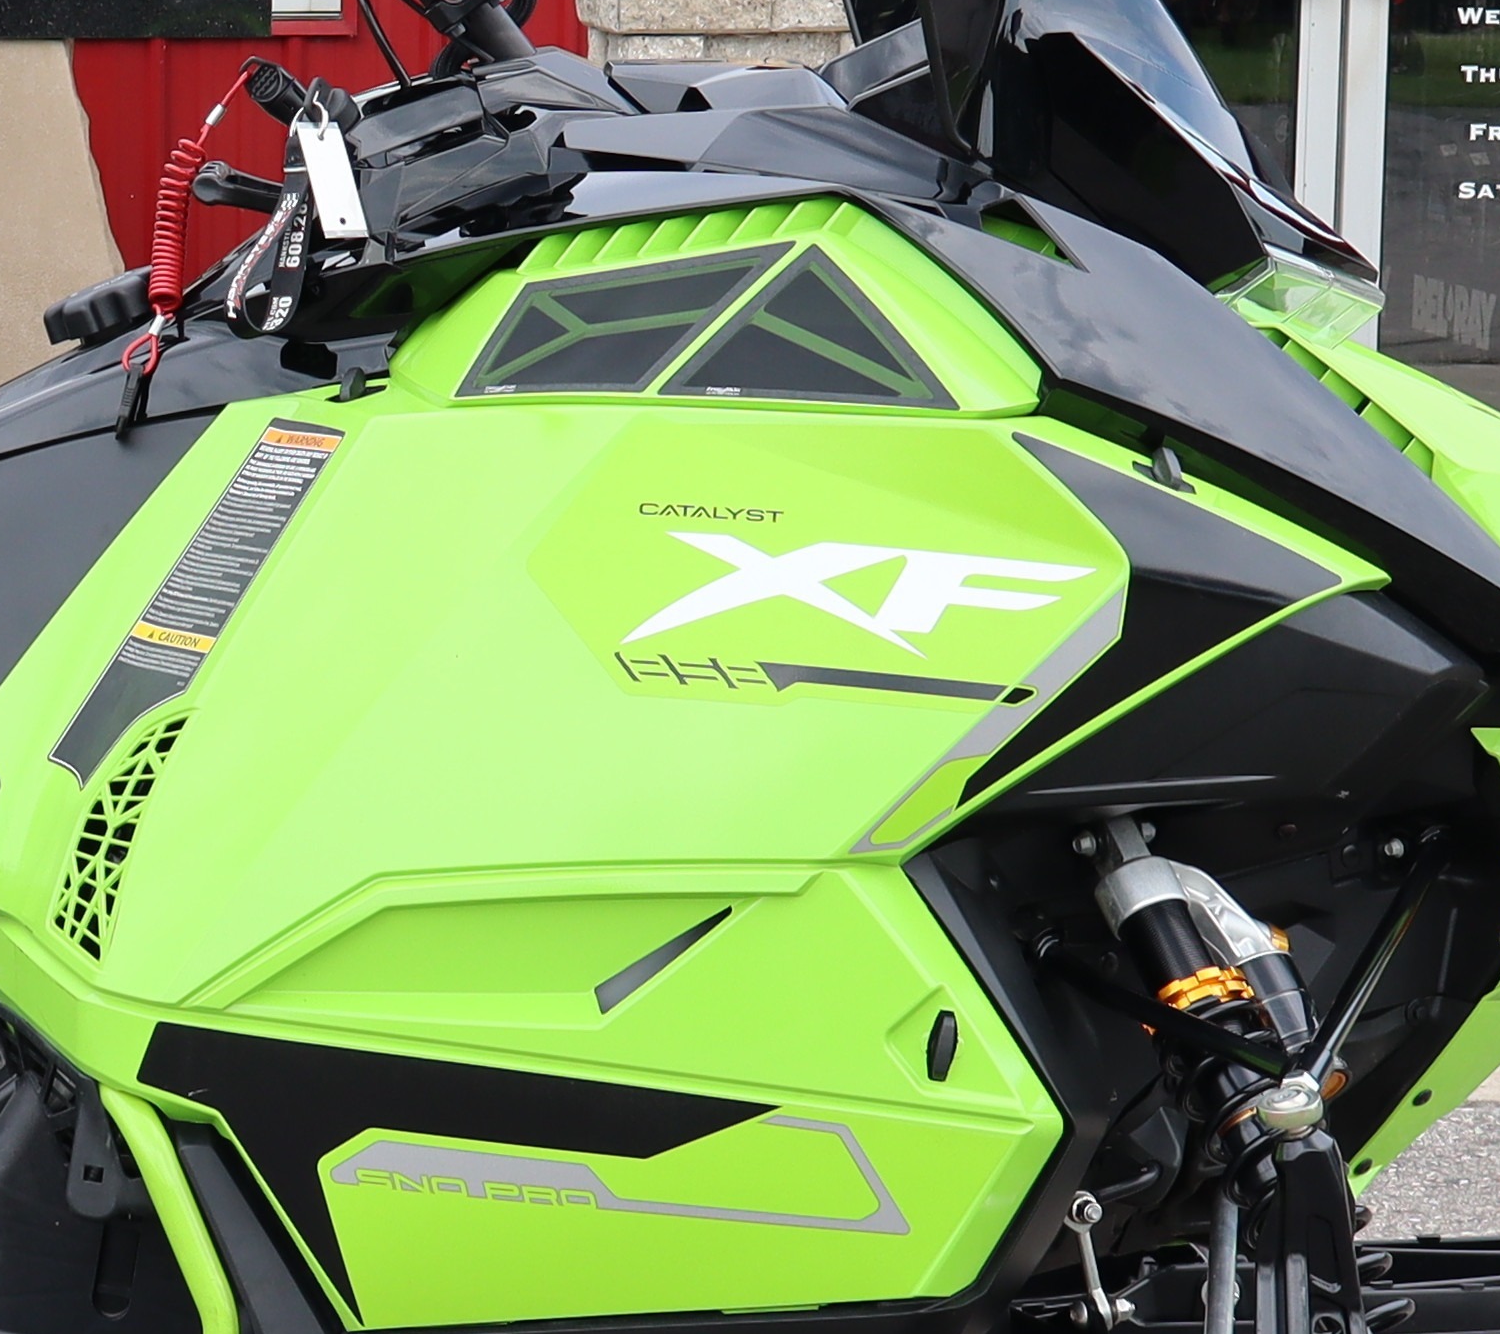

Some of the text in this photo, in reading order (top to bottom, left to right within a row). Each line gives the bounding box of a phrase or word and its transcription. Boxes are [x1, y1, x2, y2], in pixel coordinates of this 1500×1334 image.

[639, 503, 784, 523] CATALYST
[619, 530, 1098, 659] XF
[158, 631, 200, 648] CAUTION
